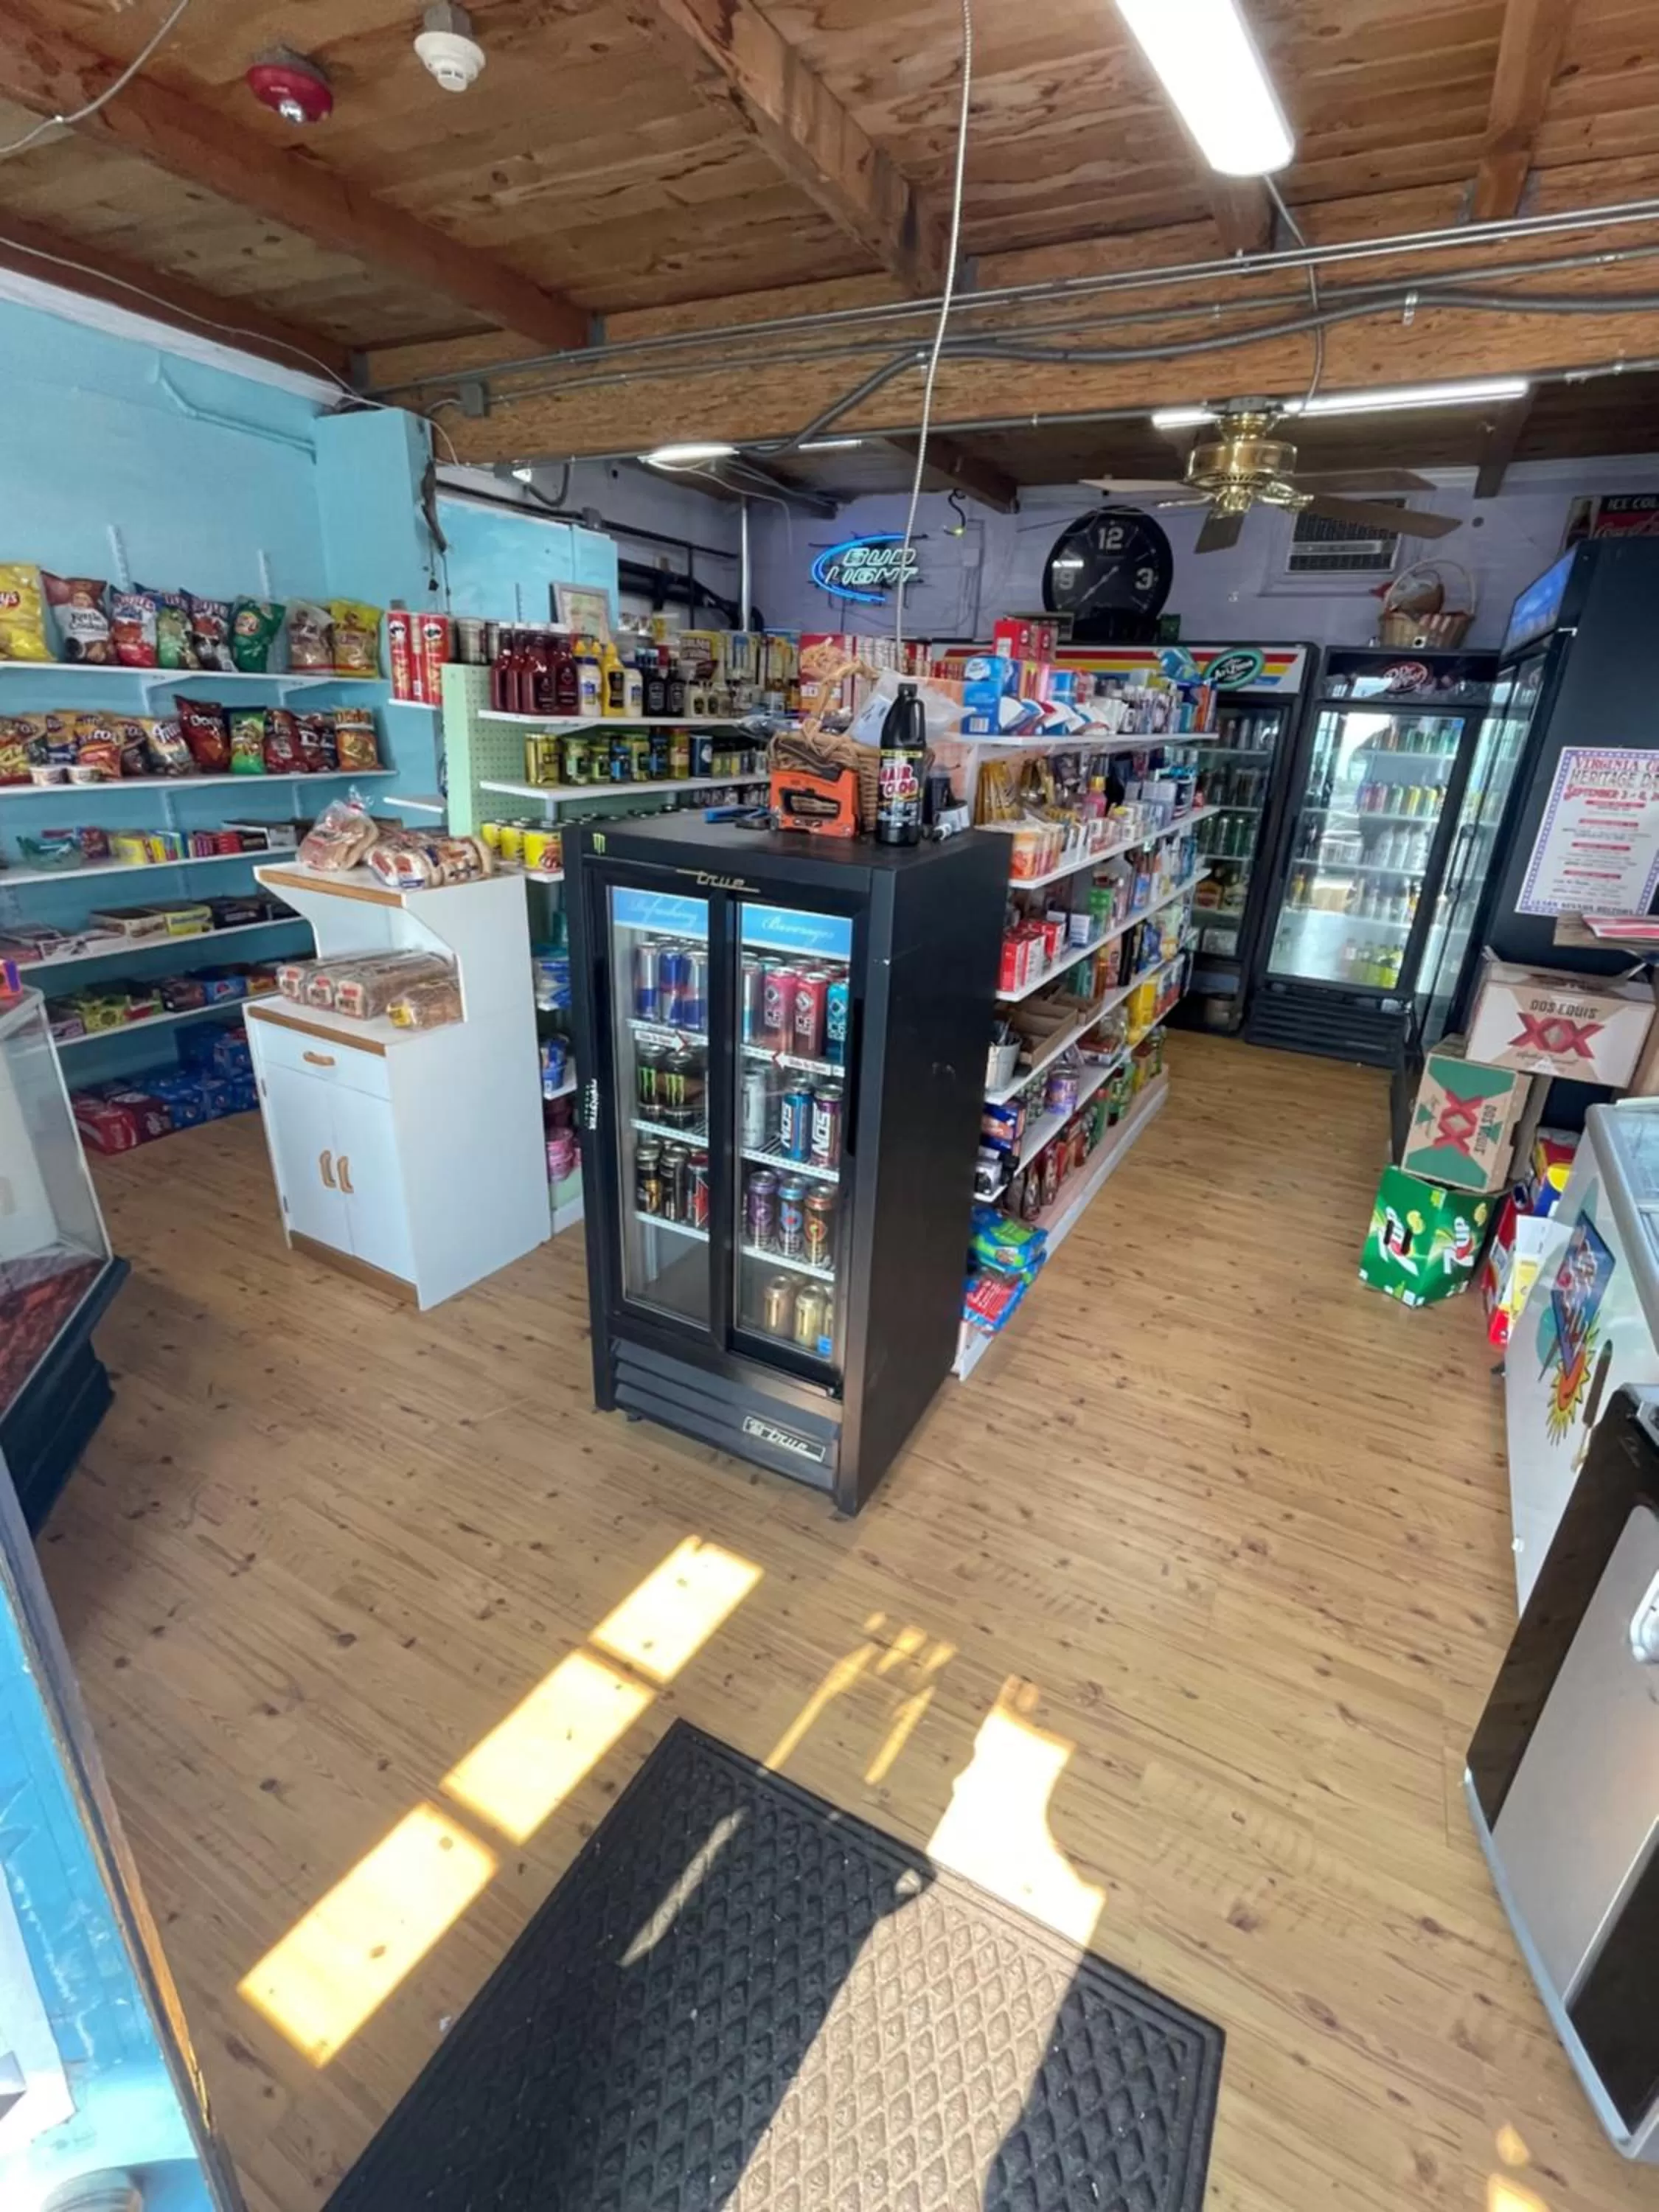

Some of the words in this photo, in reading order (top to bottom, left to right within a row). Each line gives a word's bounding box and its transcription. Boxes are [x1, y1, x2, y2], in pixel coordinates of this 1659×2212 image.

[1098, 526, 1124, 549] 12
[842, 548, 917, 566] BUD
[825, 566, 919, 585] LIGHT
[1135, 567, 1154, 590] 3
[1575, 756, 1638, 772] VIRGINIA
[1570, 768, 1638, 787] HERITAGE
[1529, 999, 1557, 1015] DOS
[1557, 1003, 1600, 1020] EQUIS
[812, 1101, 830, 1157] NOS
